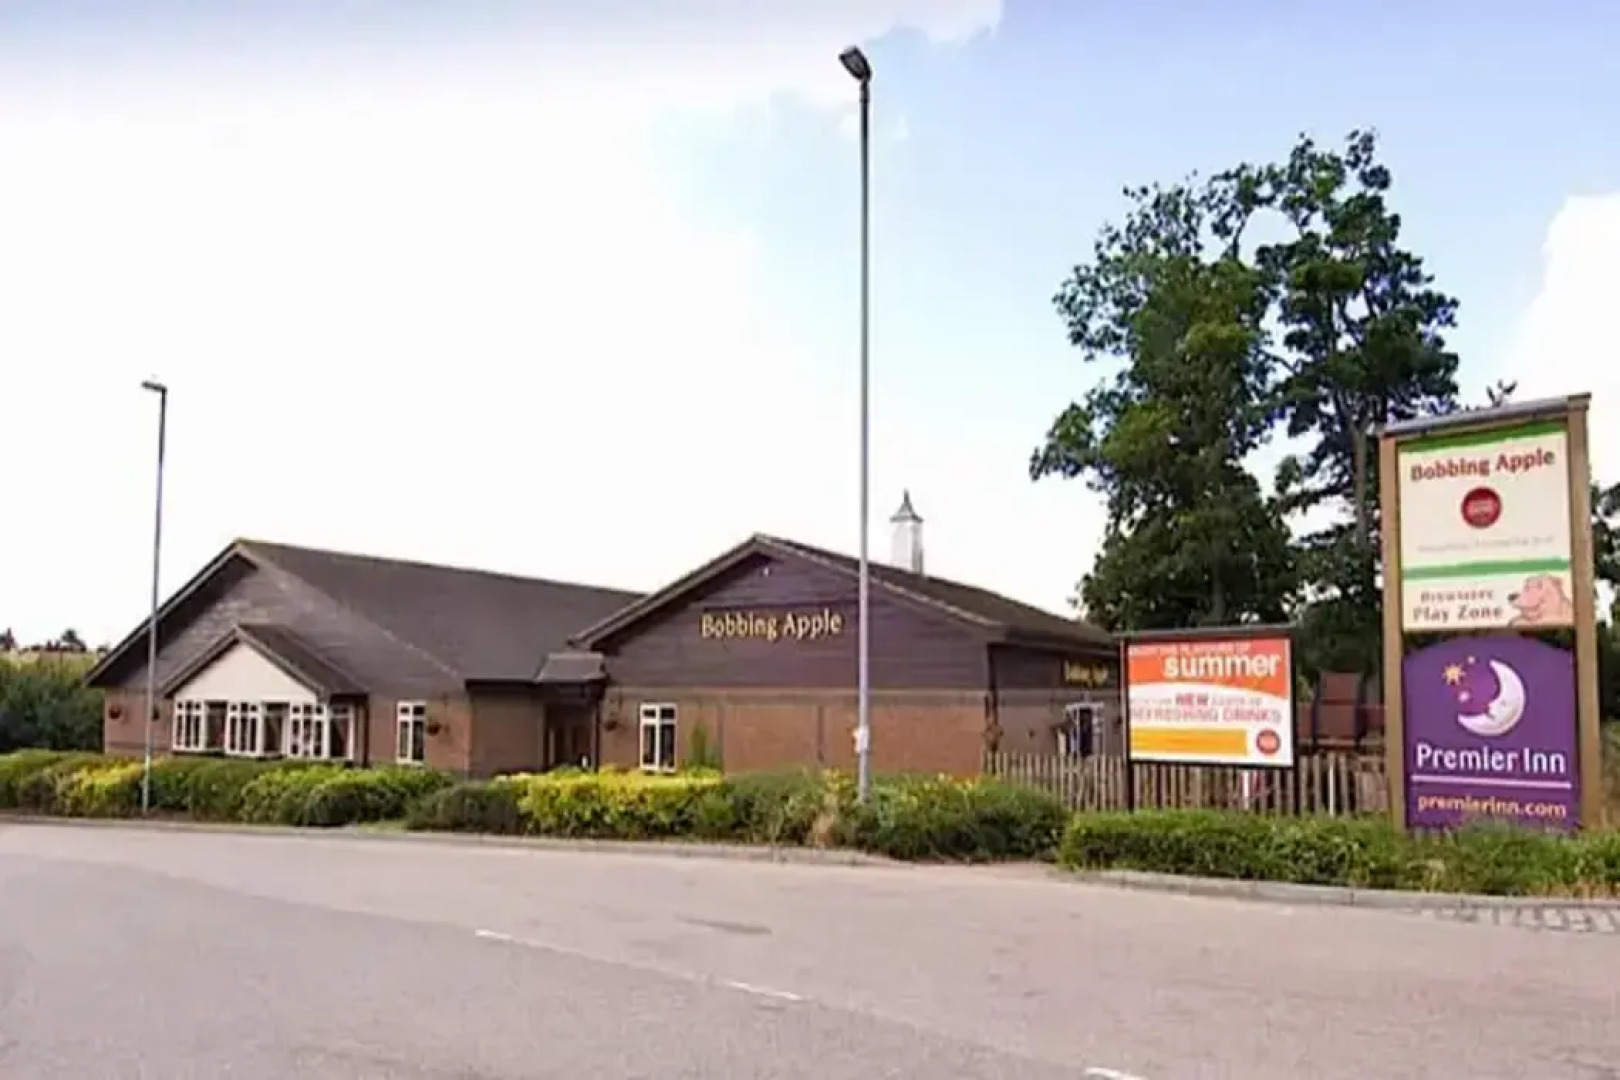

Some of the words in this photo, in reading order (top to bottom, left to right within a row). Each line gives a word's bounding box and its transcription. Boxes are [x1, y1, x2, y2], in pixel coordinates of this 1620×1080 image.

[1411, 457, 1490, 481] Bobbing
[1496, 448, 1555, 473] Apple
[702, 611, 777, 642] Bobbing
[783, 607, 842, 640] Apple
[1413, 606, 1449, 623] Play
[1458, 605, 1503, 621] Zone
[1162, 652, 1281, 677] summer
[1175, 692, 1209, 706] NEW
[1416, 742, 1518, 773] Premier
[1523, 747, 1567, 774] Inn
[1417, 796, 1568, 818] premierinn.com
